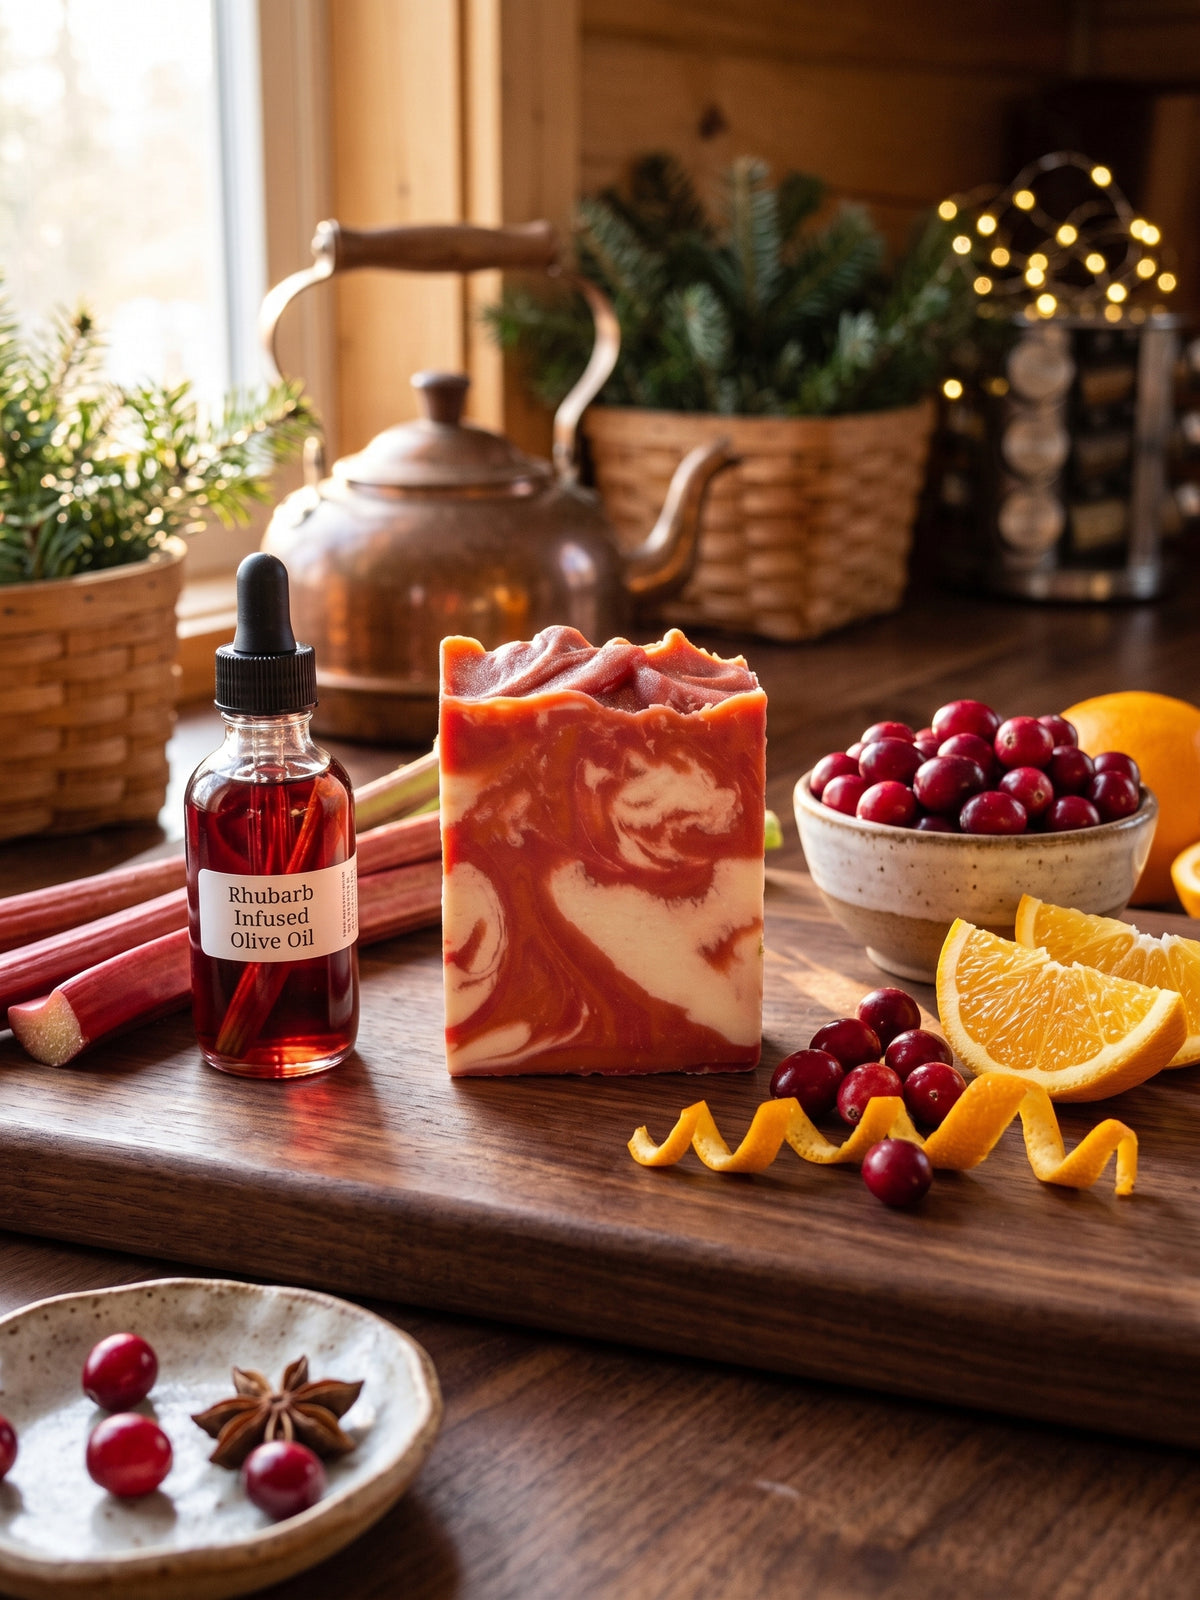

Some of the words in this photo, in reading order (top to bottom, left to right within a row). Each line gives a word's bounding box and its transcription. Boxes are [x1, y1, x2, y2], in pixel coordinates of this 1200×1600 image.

[228, 884, 314, 904] Rhubarb
[234, 907, 310, 926] Infused
[230, 931, 281, 950] Olive
[287, 929, 314, 948] Oil
